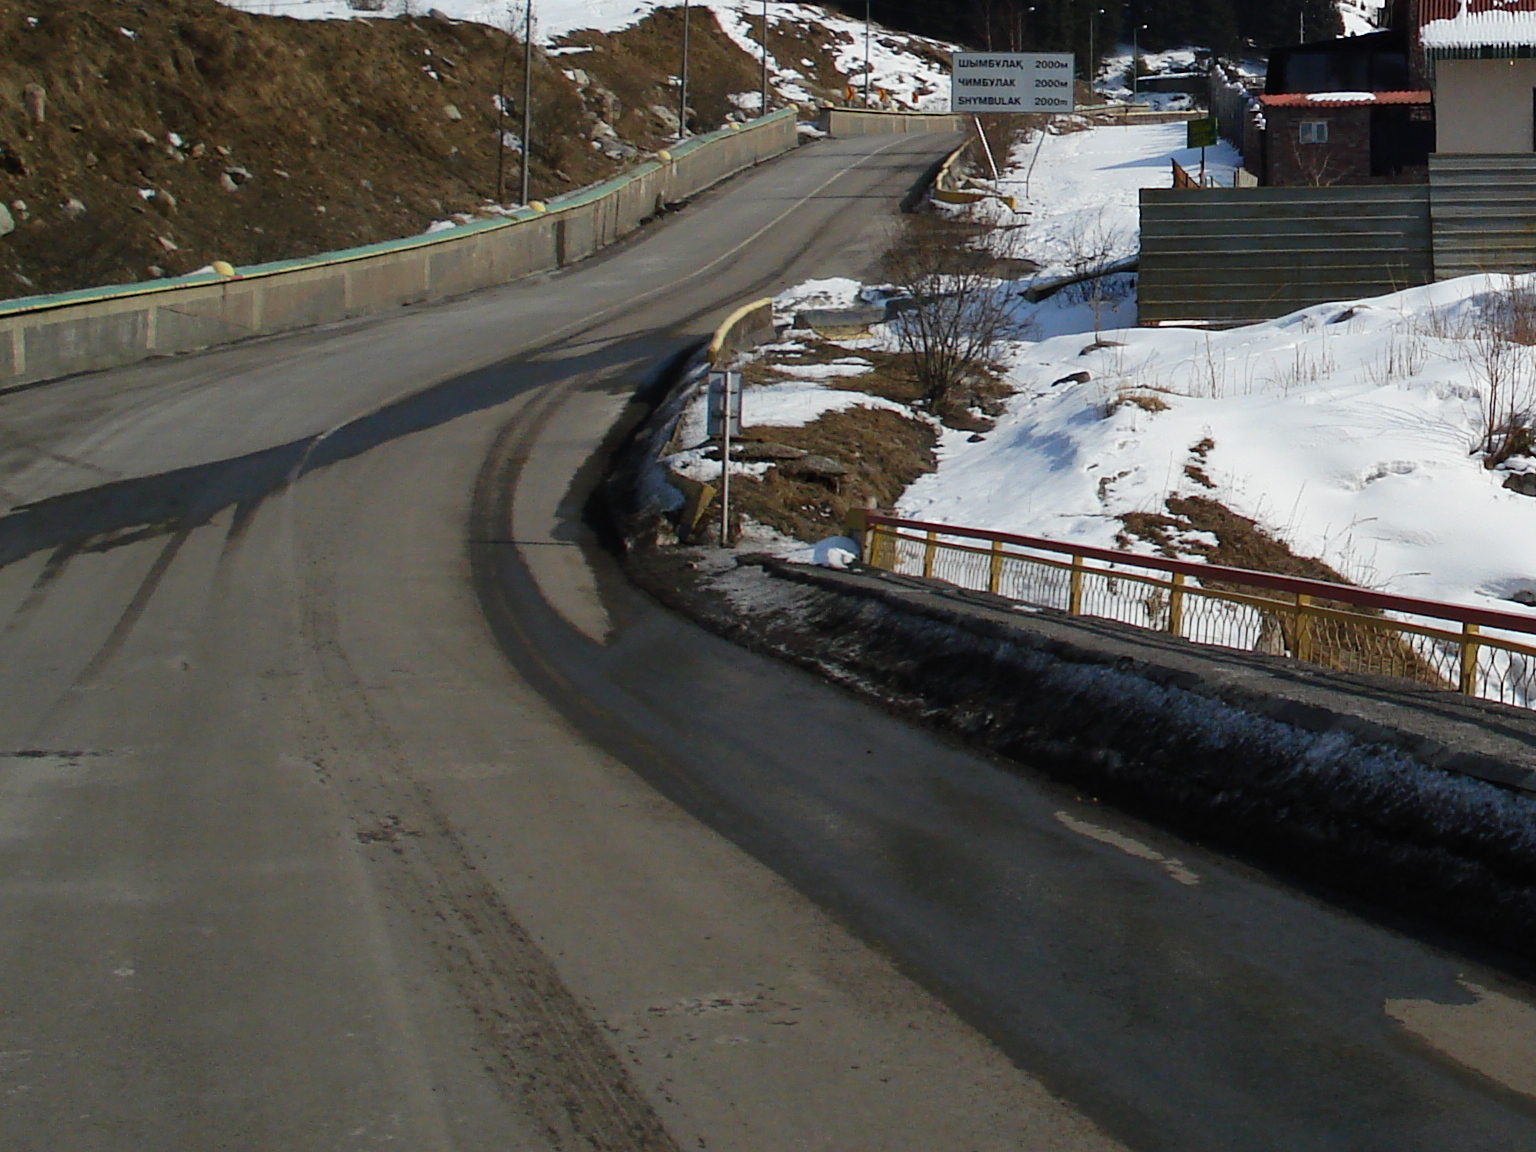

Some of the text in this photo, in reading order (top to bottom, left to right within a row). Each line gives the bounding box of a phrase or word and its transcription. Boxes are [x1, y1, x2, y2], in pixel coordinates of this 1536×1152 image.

[1034, 60, 1068, 69] 2000м
[958, 78, 1068, 88] ЧИМБУЛАК 2000м
[958, 97, 1068, 106] SHYMBULAK 2000m
